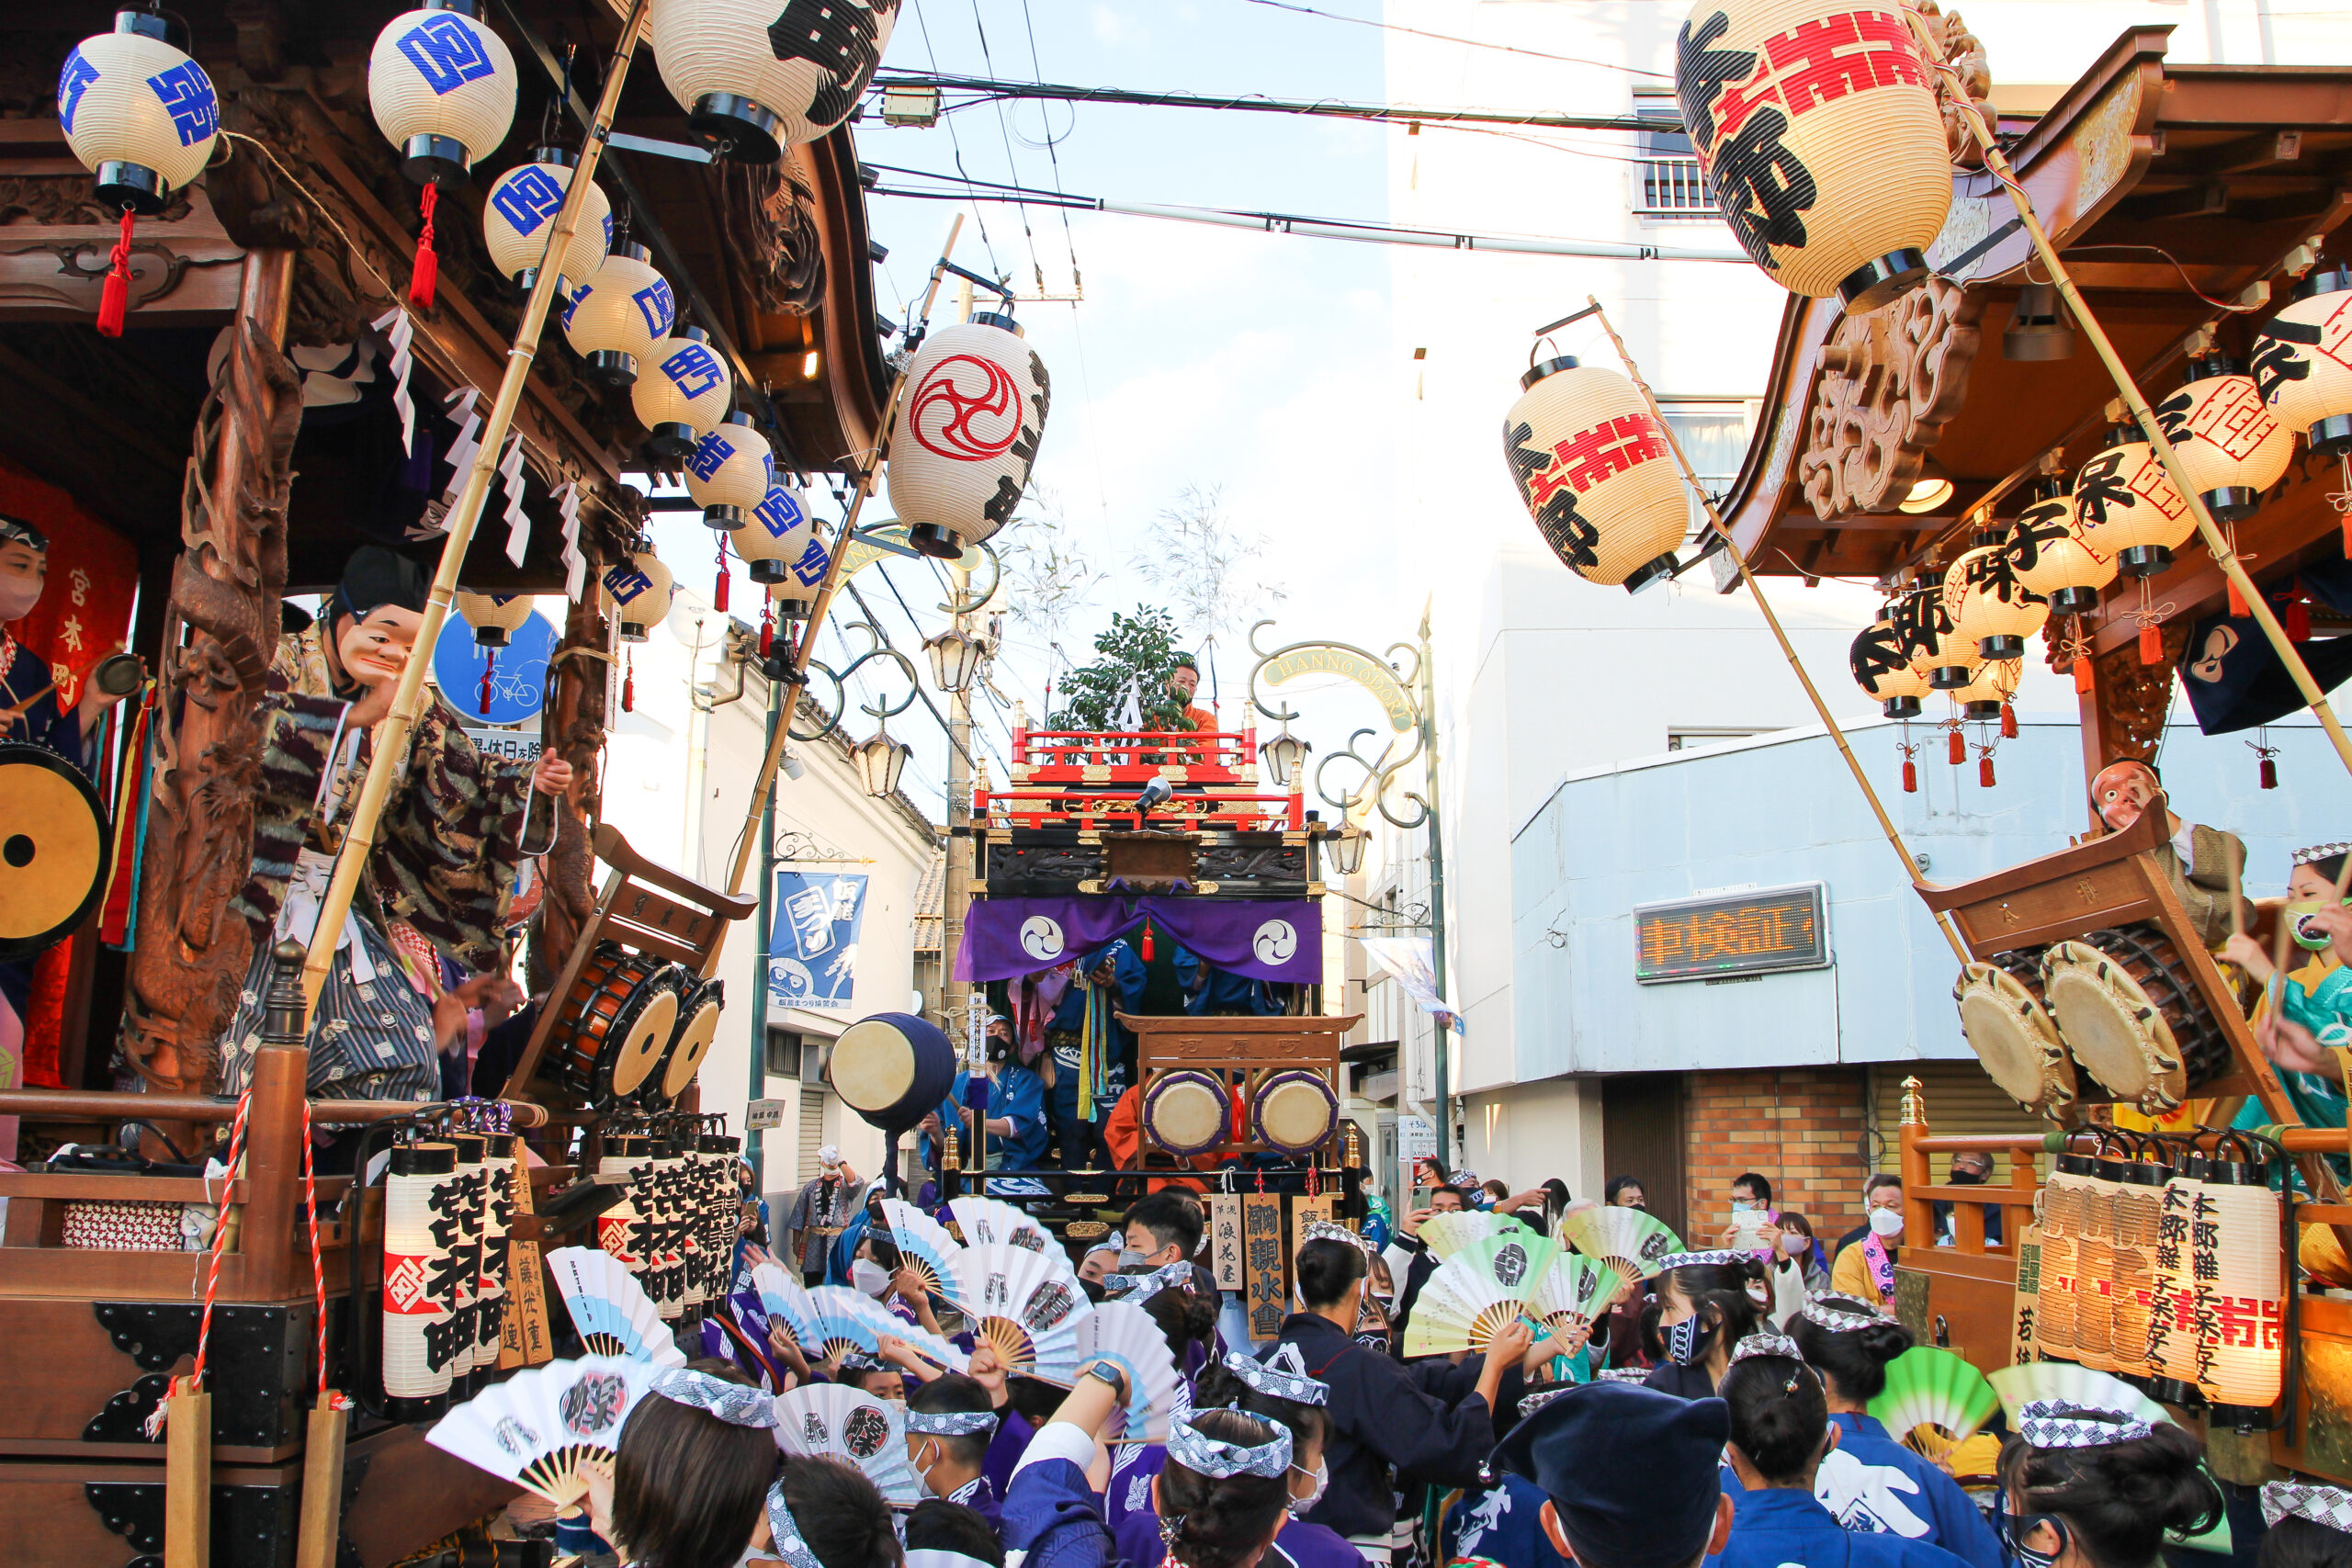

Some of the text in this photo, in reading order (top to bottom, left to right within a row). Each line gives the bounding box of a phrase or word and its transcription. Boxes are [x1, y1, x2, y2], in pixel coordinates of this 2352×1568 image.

[51, 568, 91, 706] 宮本町
[1278, 653, 1407, 720] HANNO ODORI
[791, 892, 829, 953] まつり
[831, 879, 859, 921] 飯能
[1643, 906, 1815, 965] 車検証
[1218, 1221, 1237, 1283] 浪花屋
